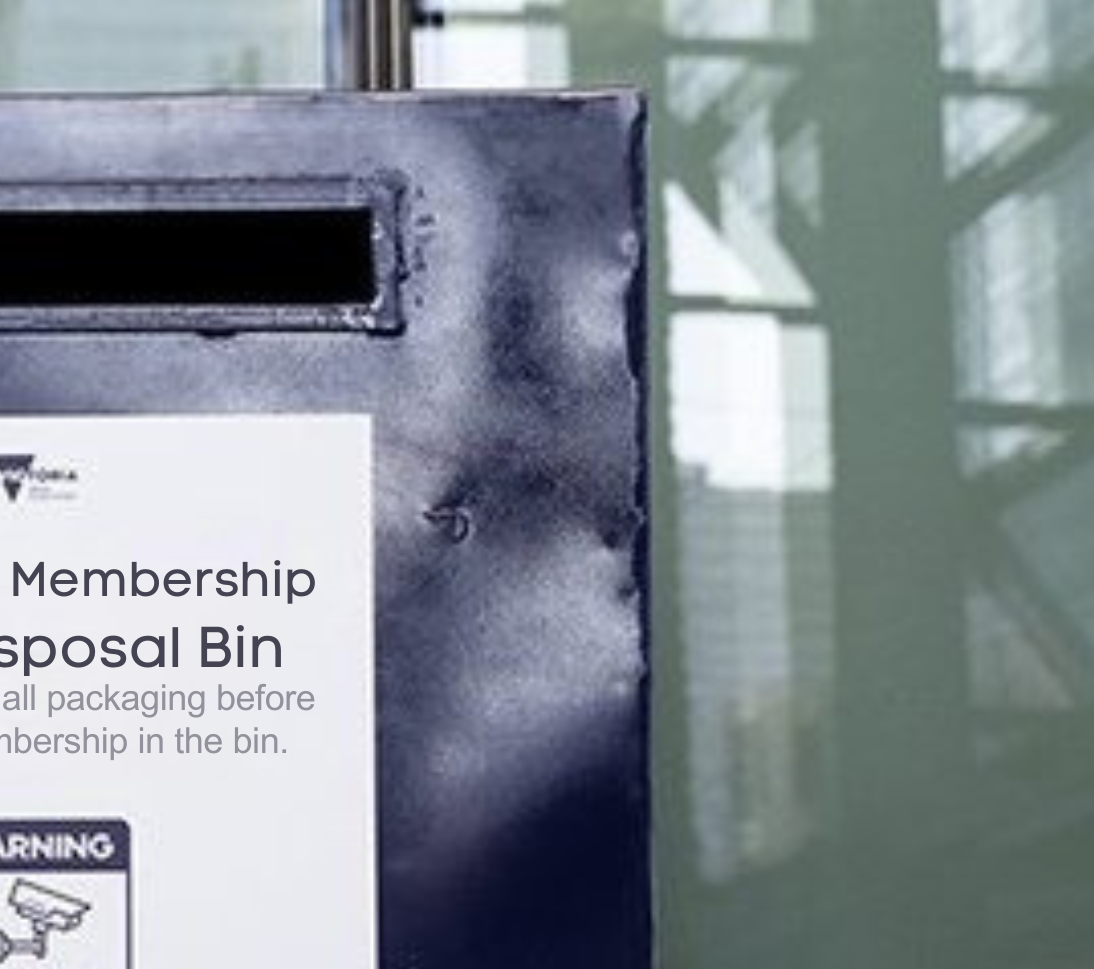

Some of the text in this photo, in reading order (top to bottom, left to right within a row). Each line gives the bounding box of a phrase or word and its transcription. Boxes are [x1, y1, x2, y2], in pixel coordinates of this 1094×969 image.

[13, 560, 316, 605] Membership
[201, 625, 282, 668] Bin
[3, 684, 36, 711] all
[48, 684, 205, 719] packaging
[218, 684, 315, 711] before
[140, 727, 164, 754] in
[175, 727, 223, 754] the
[235, 727, 287, 754] bin.
